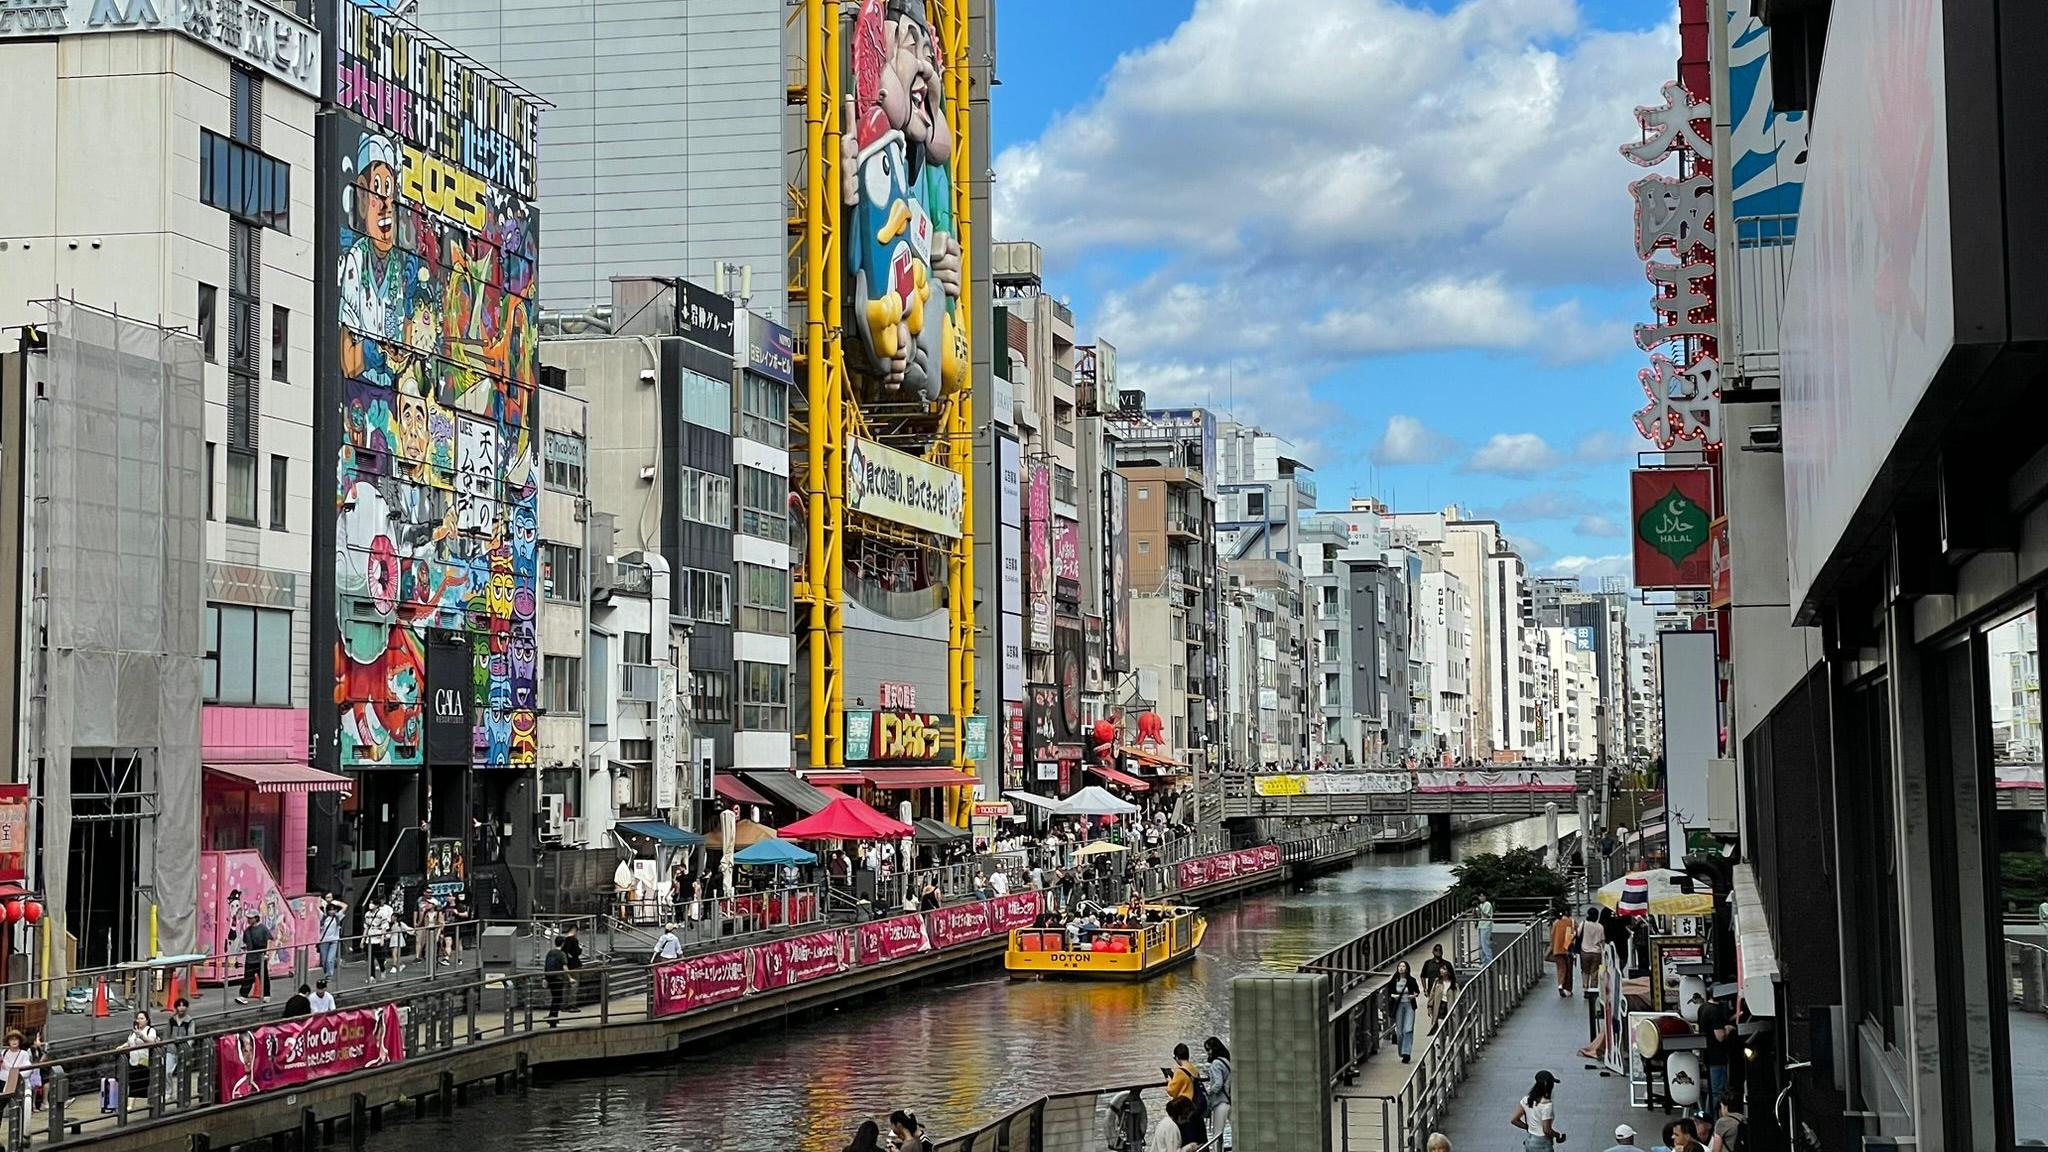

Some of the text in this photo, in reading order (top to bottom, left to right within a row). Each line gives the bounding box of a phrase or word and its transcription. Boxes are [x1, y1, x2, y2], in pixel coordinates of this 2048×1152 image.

[401, 145, 487, 232] 2025
[1619, 81, 1722, 450] 大阪王将
[1656, 513, 1694, 534] حلال
[1660, 535, 1692, 543] HALAL
[435, 688, 464, 717] GALA
[1051, 954, 1091, 962] DOTON
[320, 1027, 338, 1046] Our
